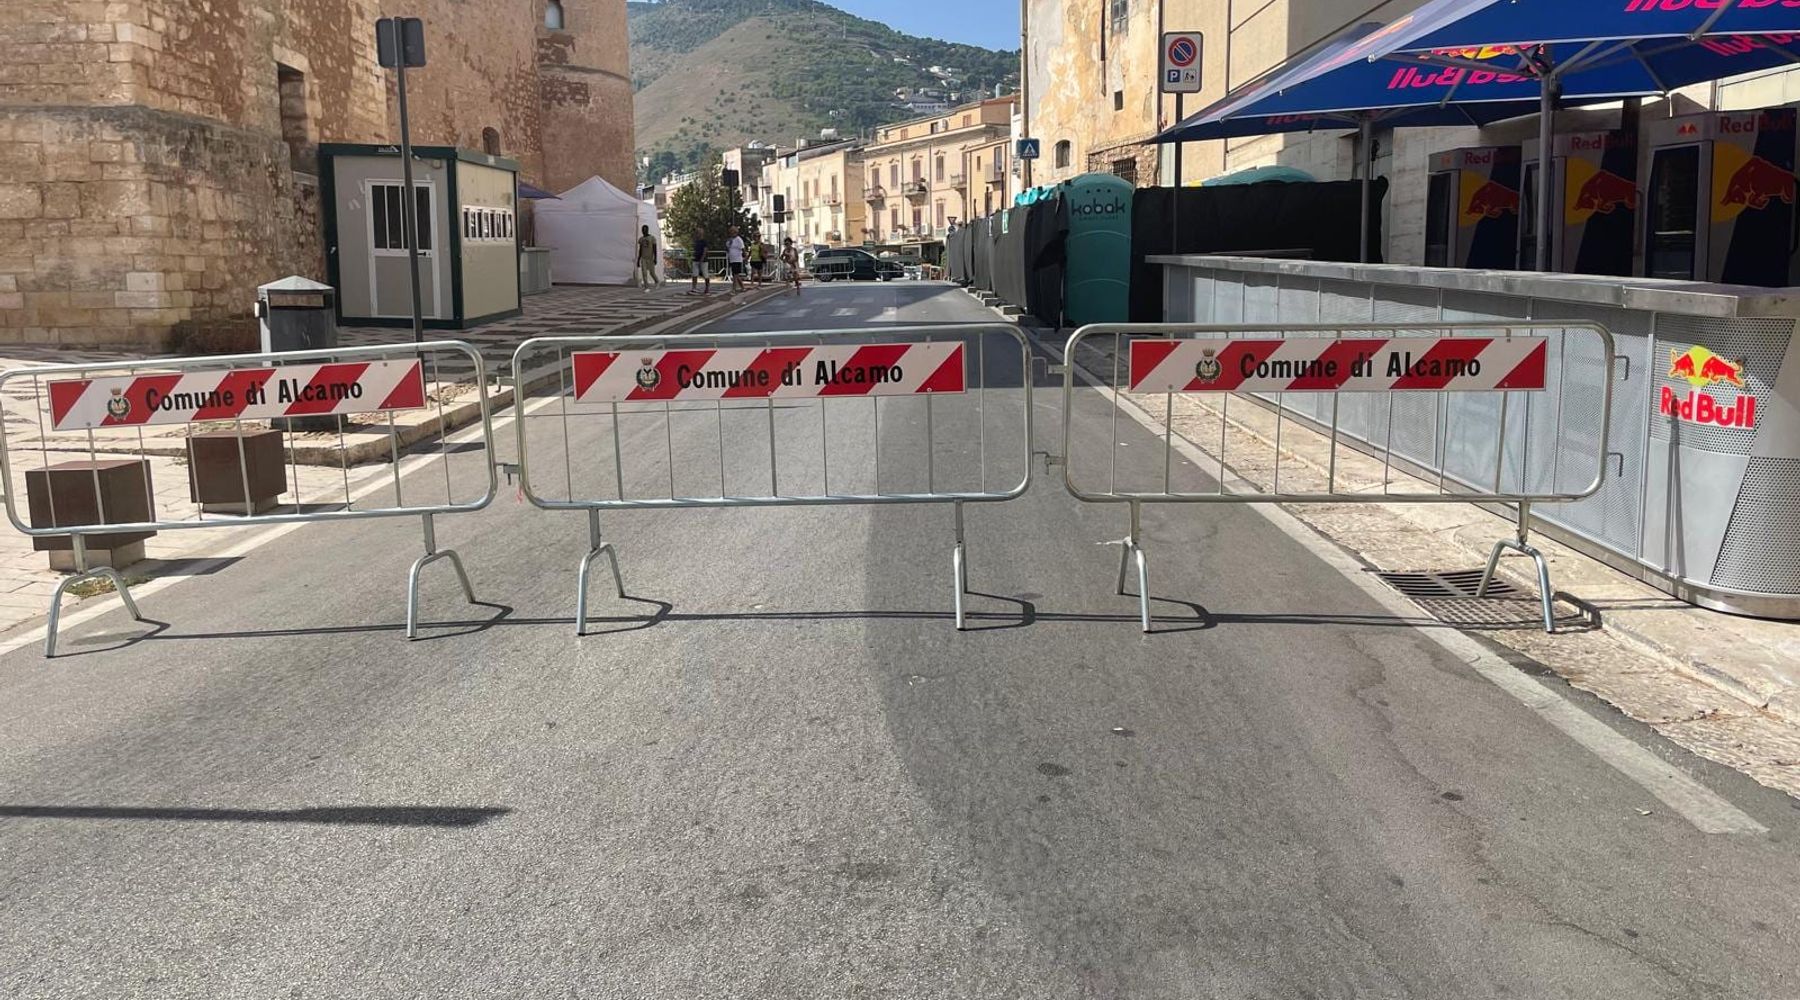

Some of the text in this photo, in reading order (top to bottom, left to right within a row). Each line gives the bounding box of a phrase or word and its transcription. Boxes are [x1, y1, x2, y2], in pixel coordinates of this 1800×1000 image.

[1170, 72, 1178, 82] P
[1720, 114, 1755, 133] Red
[1571, 136, 1600, 150] Red
[1464, 151, 1491, 165] Red
[1071, 196, 1126, 215] kobak
[677, 360, 904, 390] Comune di Alcamo
[1240, 352, 1481, 379] Comune di Alcamo
[145, 378, 363, 413] Comune di Alcamo
[1661, 386, 1756, 428] Red Bull
